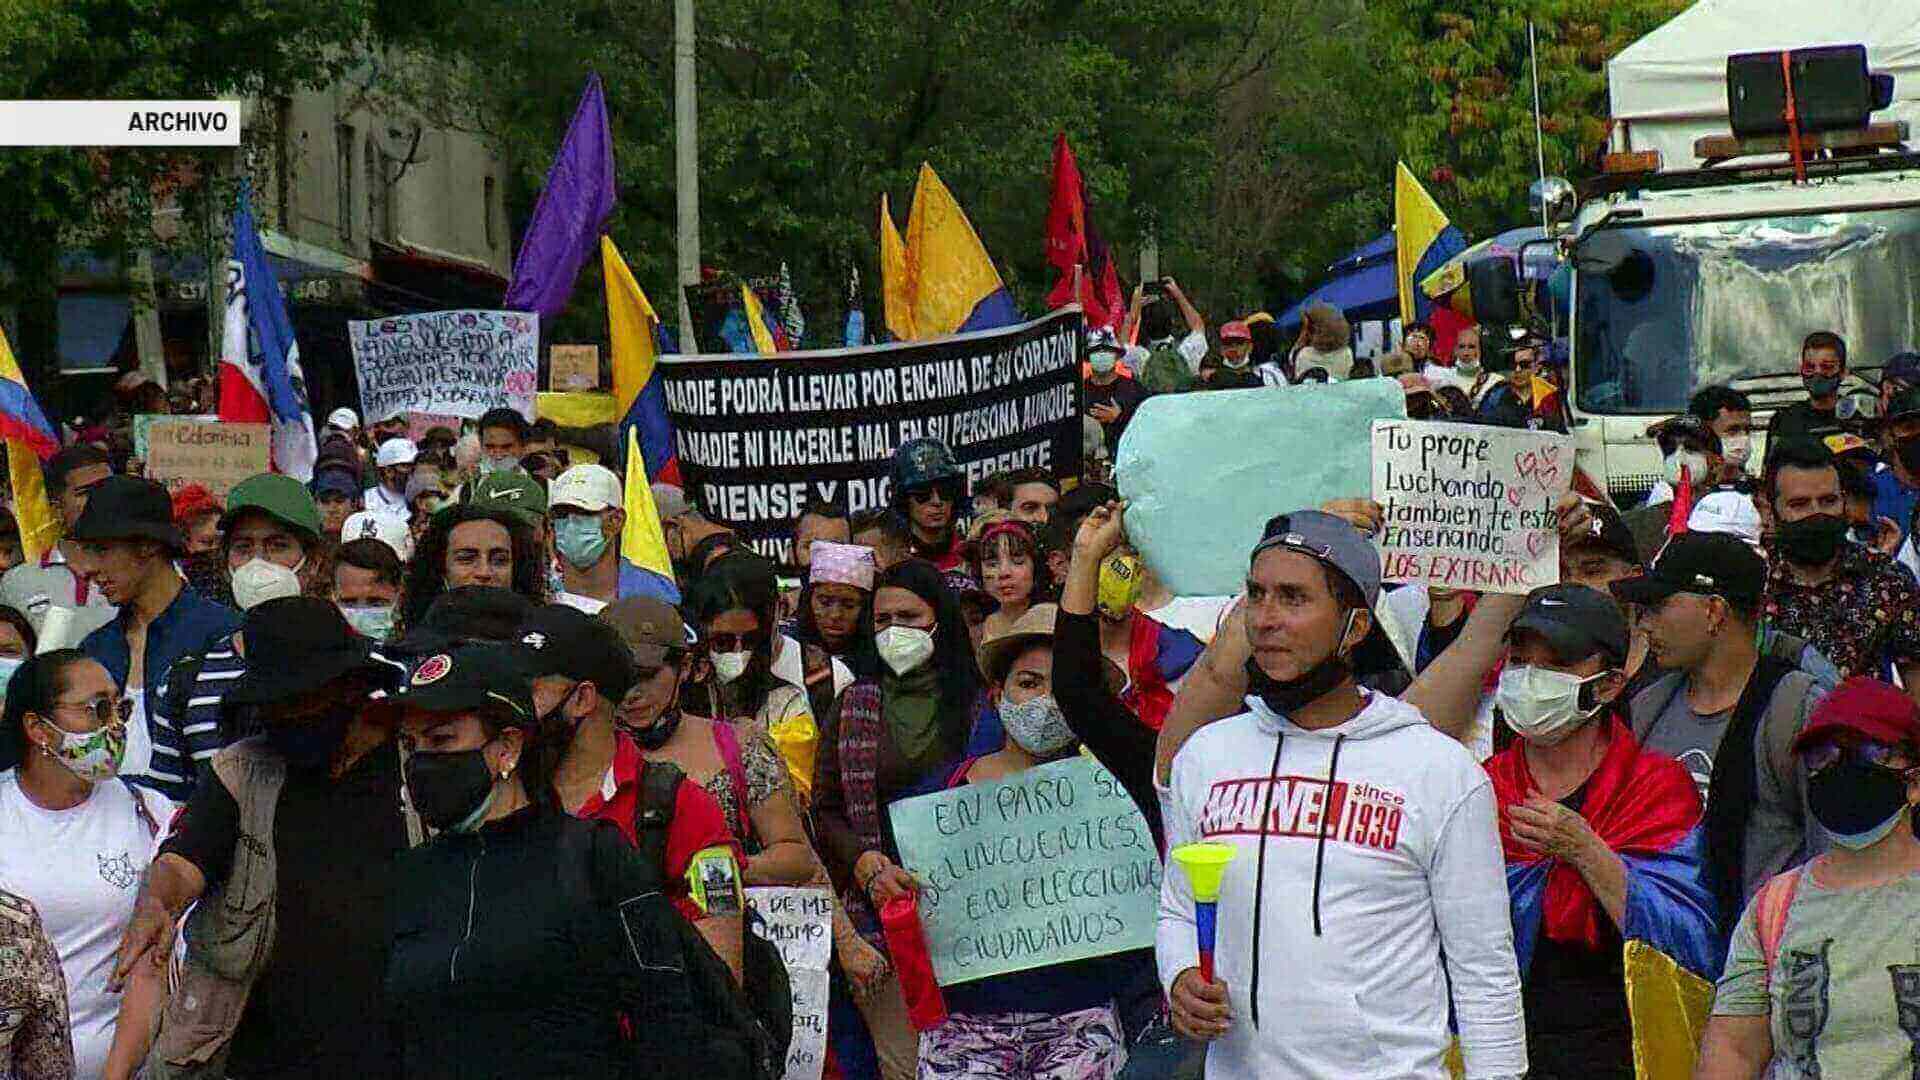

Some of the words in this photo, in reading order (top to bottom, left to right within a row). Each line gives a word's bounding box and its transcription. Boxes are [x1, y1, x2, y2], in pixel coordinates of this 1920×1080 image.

[664, 378, 717, 415] NADIE
[721, 368, 782, 414] PODRÁ
[786, 373, 858, 412] LLEVAR
[862, 370, 897, 405] POR
[901, 358, 967, 402] ENCIMA
[971, 356, 993, 394] DE
[993, 350, 1013, 387] SU
[1013, 323, 1077, 380] CORAZÓN
[687, 429, 740, 469] NADIE
[744, 428, 764, 467] NI
[768, 424, 853, 467] HACERLE
[859, 422, 894, 462] MAL
[951, 397, 1020, 447] PERSONA
[1023, 381, 1078, 427] AUNQUE
[1377, 425, 1411, 451] Tu
[1421, 434, 1490, 471] profe
[703, 481, 808, 521] PIENSE
[820, 481, 839, 503] Y
[1386, 461, 1504, 500] Luchando
[1488, 500, 1512, 531] te
[1383, 553, 1421, 579] LOS
[934, 793, 981, 836] EN
[996, 775, 1075, 821] PARO
[1353, 782, 1406, 806] since
[1346, 799, 1402, 850] 1939
[966, 886, 1010, 921] EN
[953, 911, 1125, 967] CIUDADANOS
